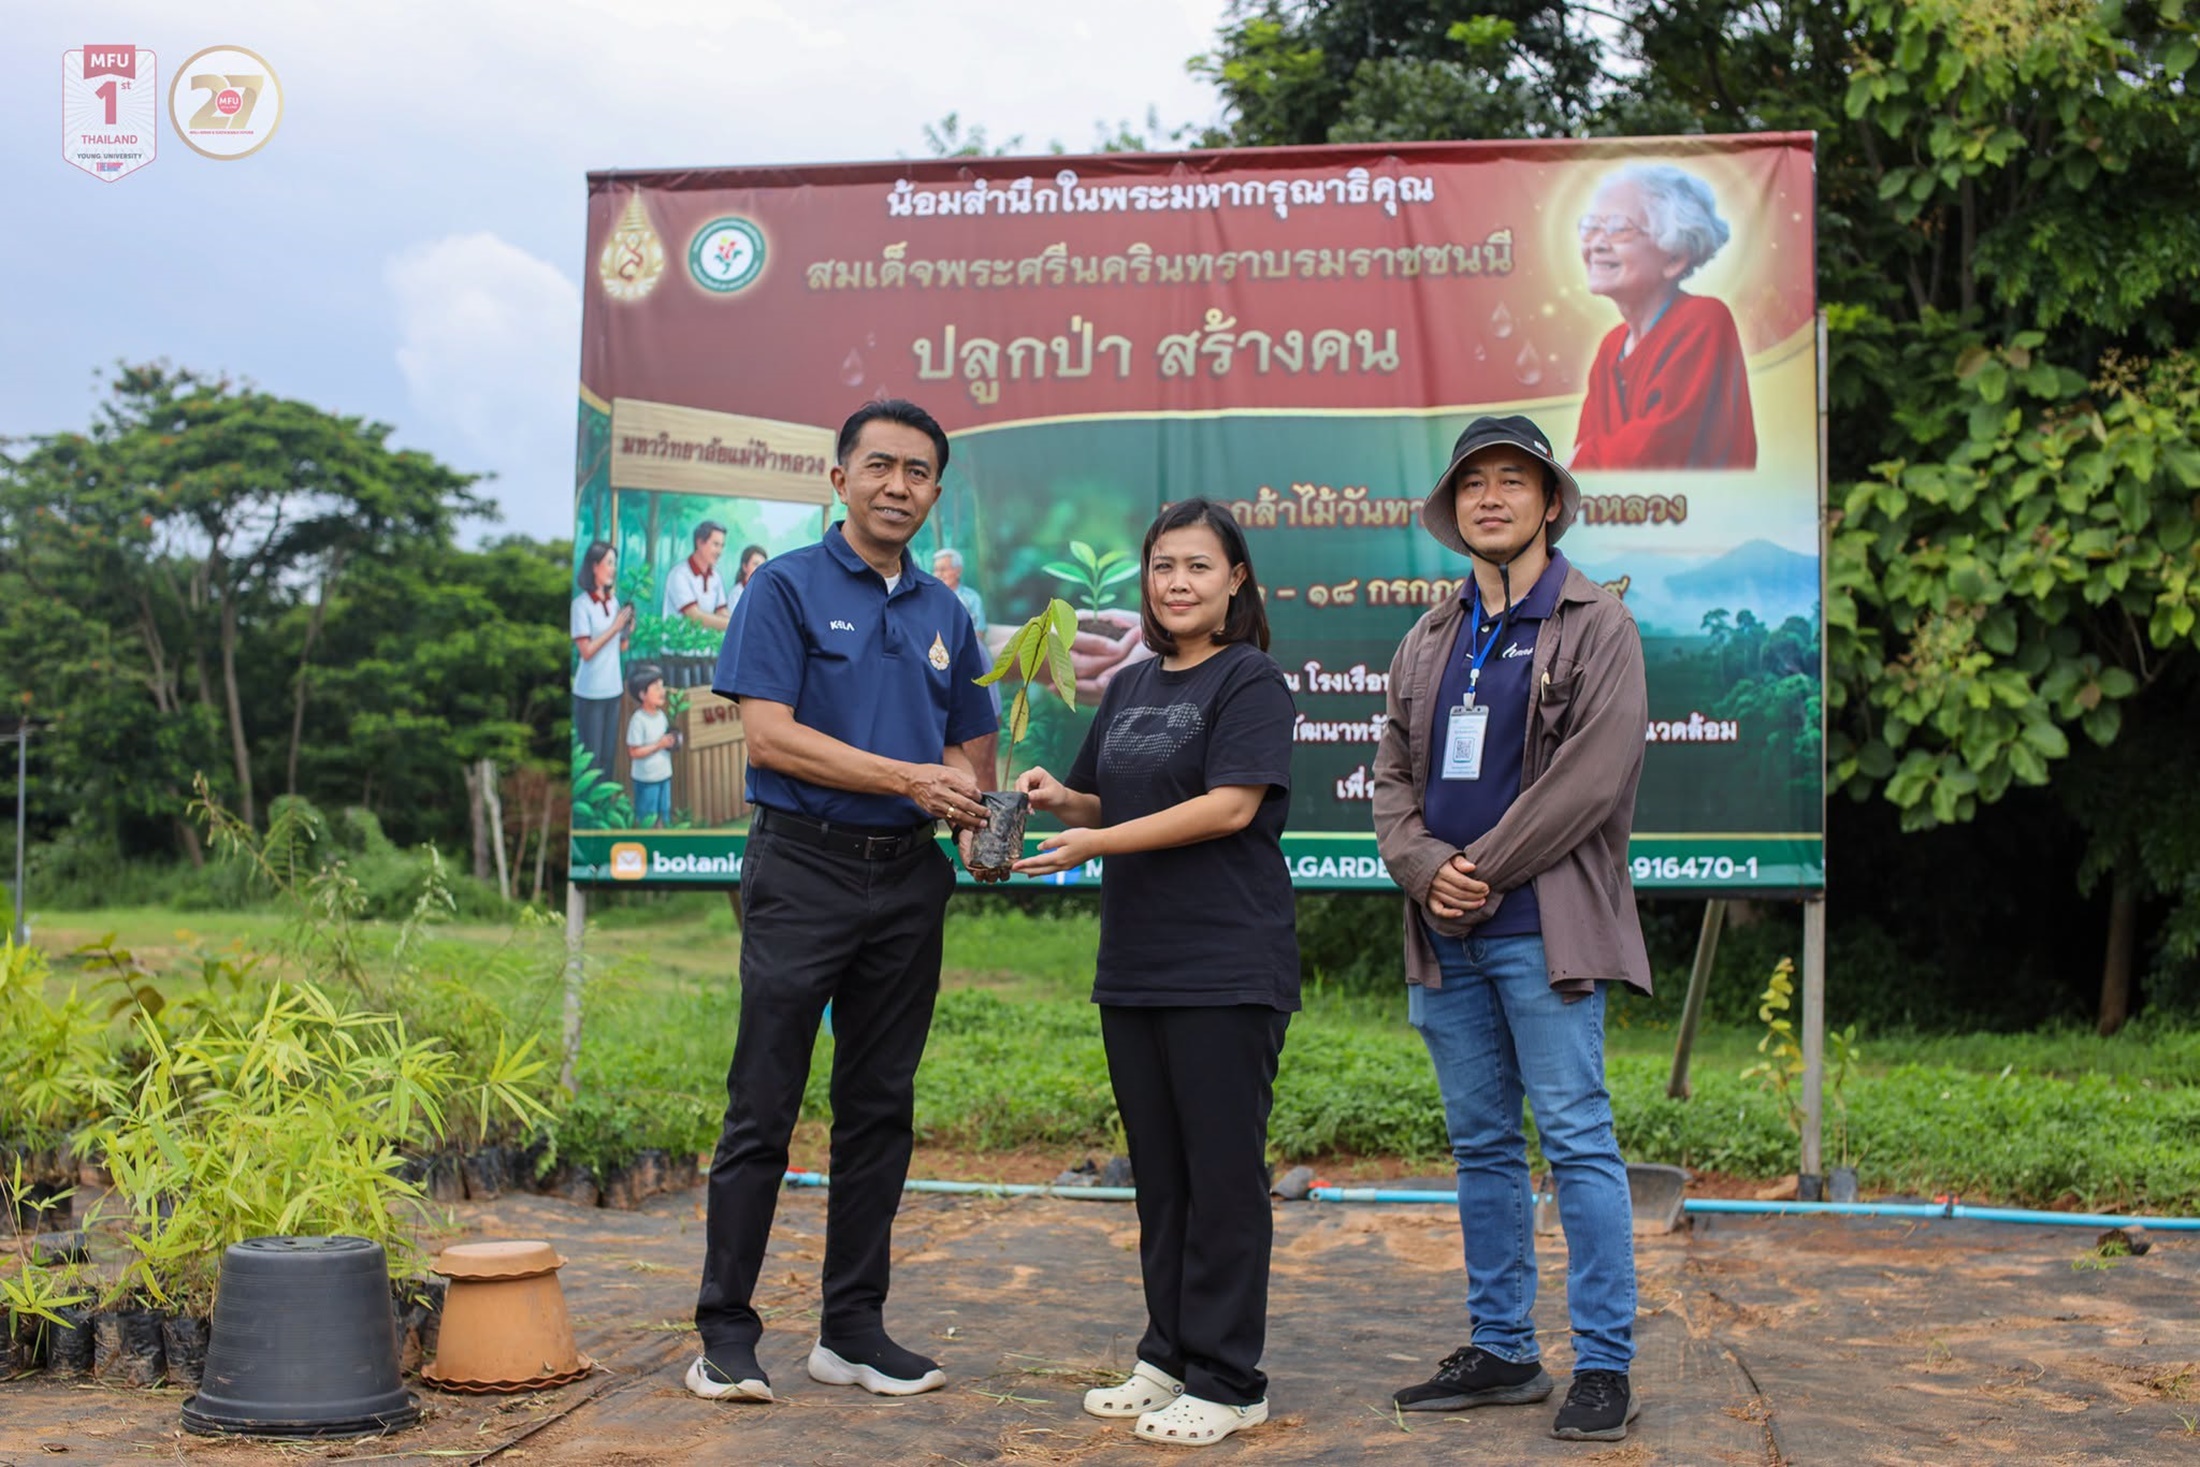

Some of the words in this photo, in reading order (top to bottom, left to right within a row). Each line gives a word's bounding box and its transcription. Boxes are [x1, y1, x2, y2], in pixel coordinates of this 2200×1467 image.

[886, 167, 1434, 219] น้อมสำนึกในพระมหากรุณาธิคุณ
[806, 229, 1514, 291] สมเด็จพระศรีนครินทราบรมราชชนนี
[912, 314, 1132, 405] ปลูกป่า
[1157, 307, 1401, 377] สร้างคน
